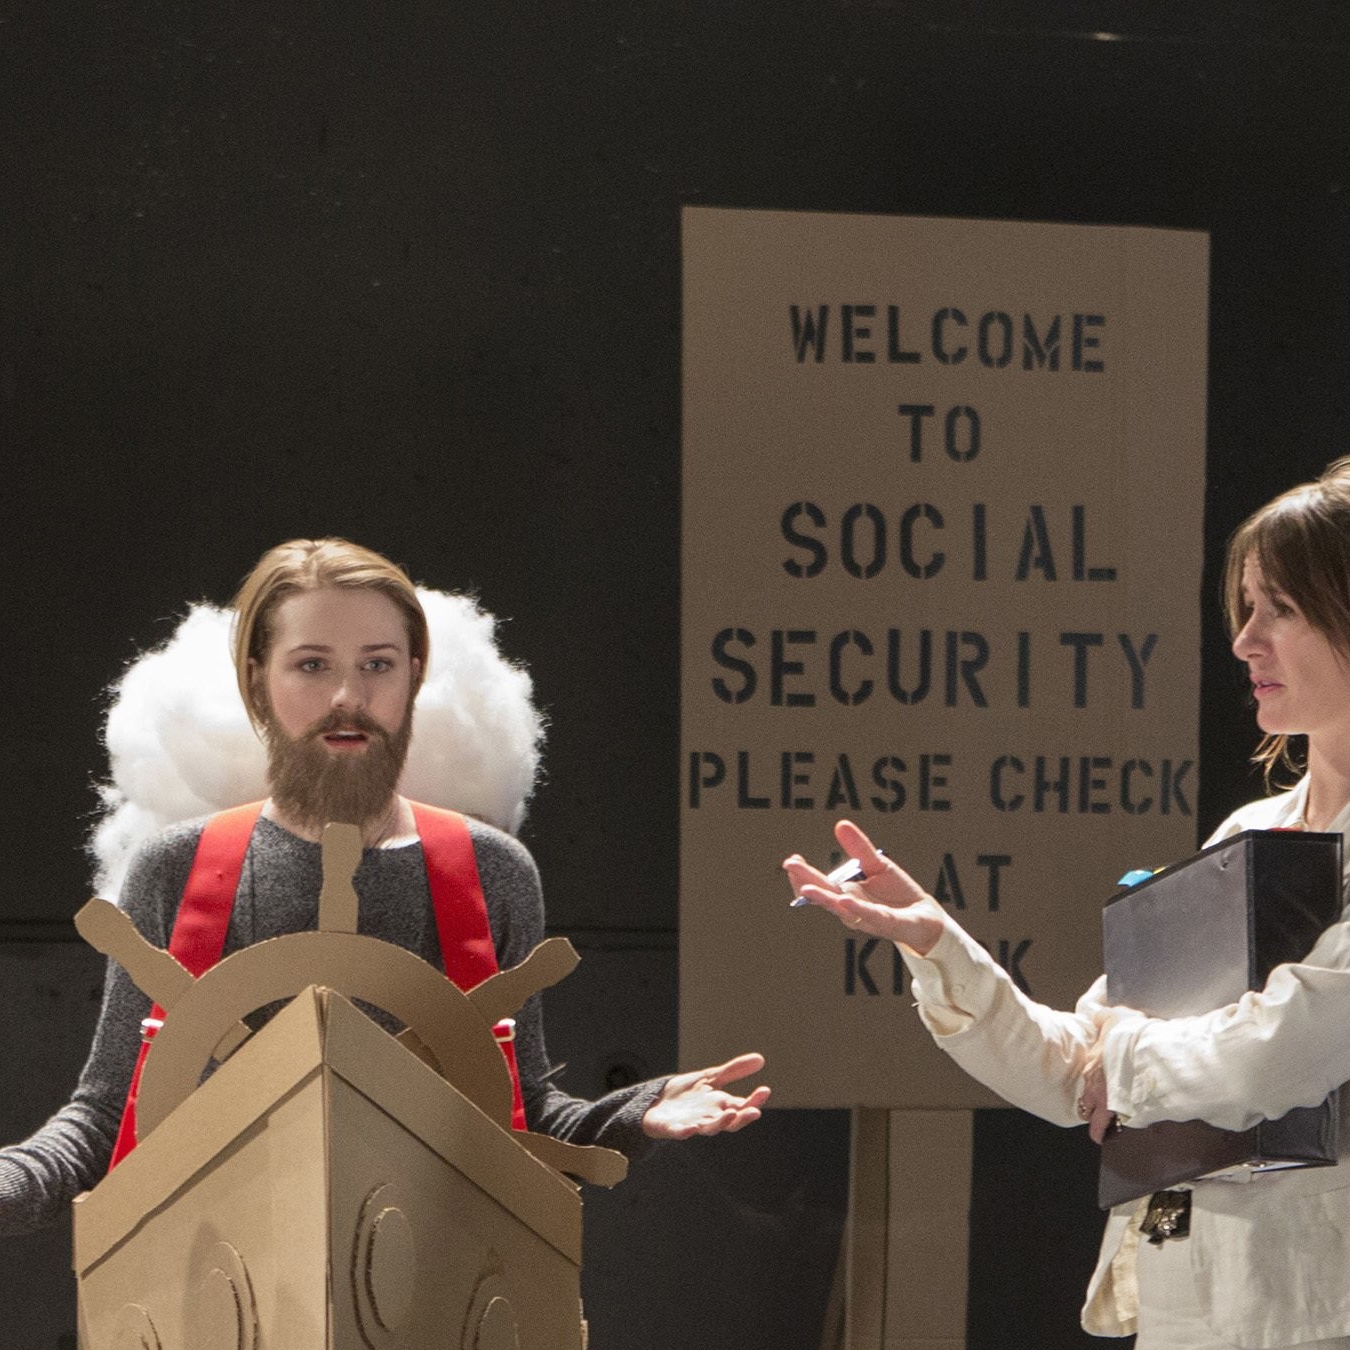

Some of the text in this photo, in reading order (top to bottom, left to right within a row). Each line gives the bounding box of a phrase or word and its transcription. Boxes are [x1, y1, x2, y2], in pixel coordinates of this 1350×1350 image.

[790, 305, 1106, 372] WELCOME
[898, 404, 982, 463] TO
[781, 501, 1117, 581] SOCIAL
[711, 628, 1158, 709] SECURITY
[688, 752, 1194, 816] PLEASE CHECK
[934, 853, 1011, 912] AT
[844, 938, 1034, 996] KIK
